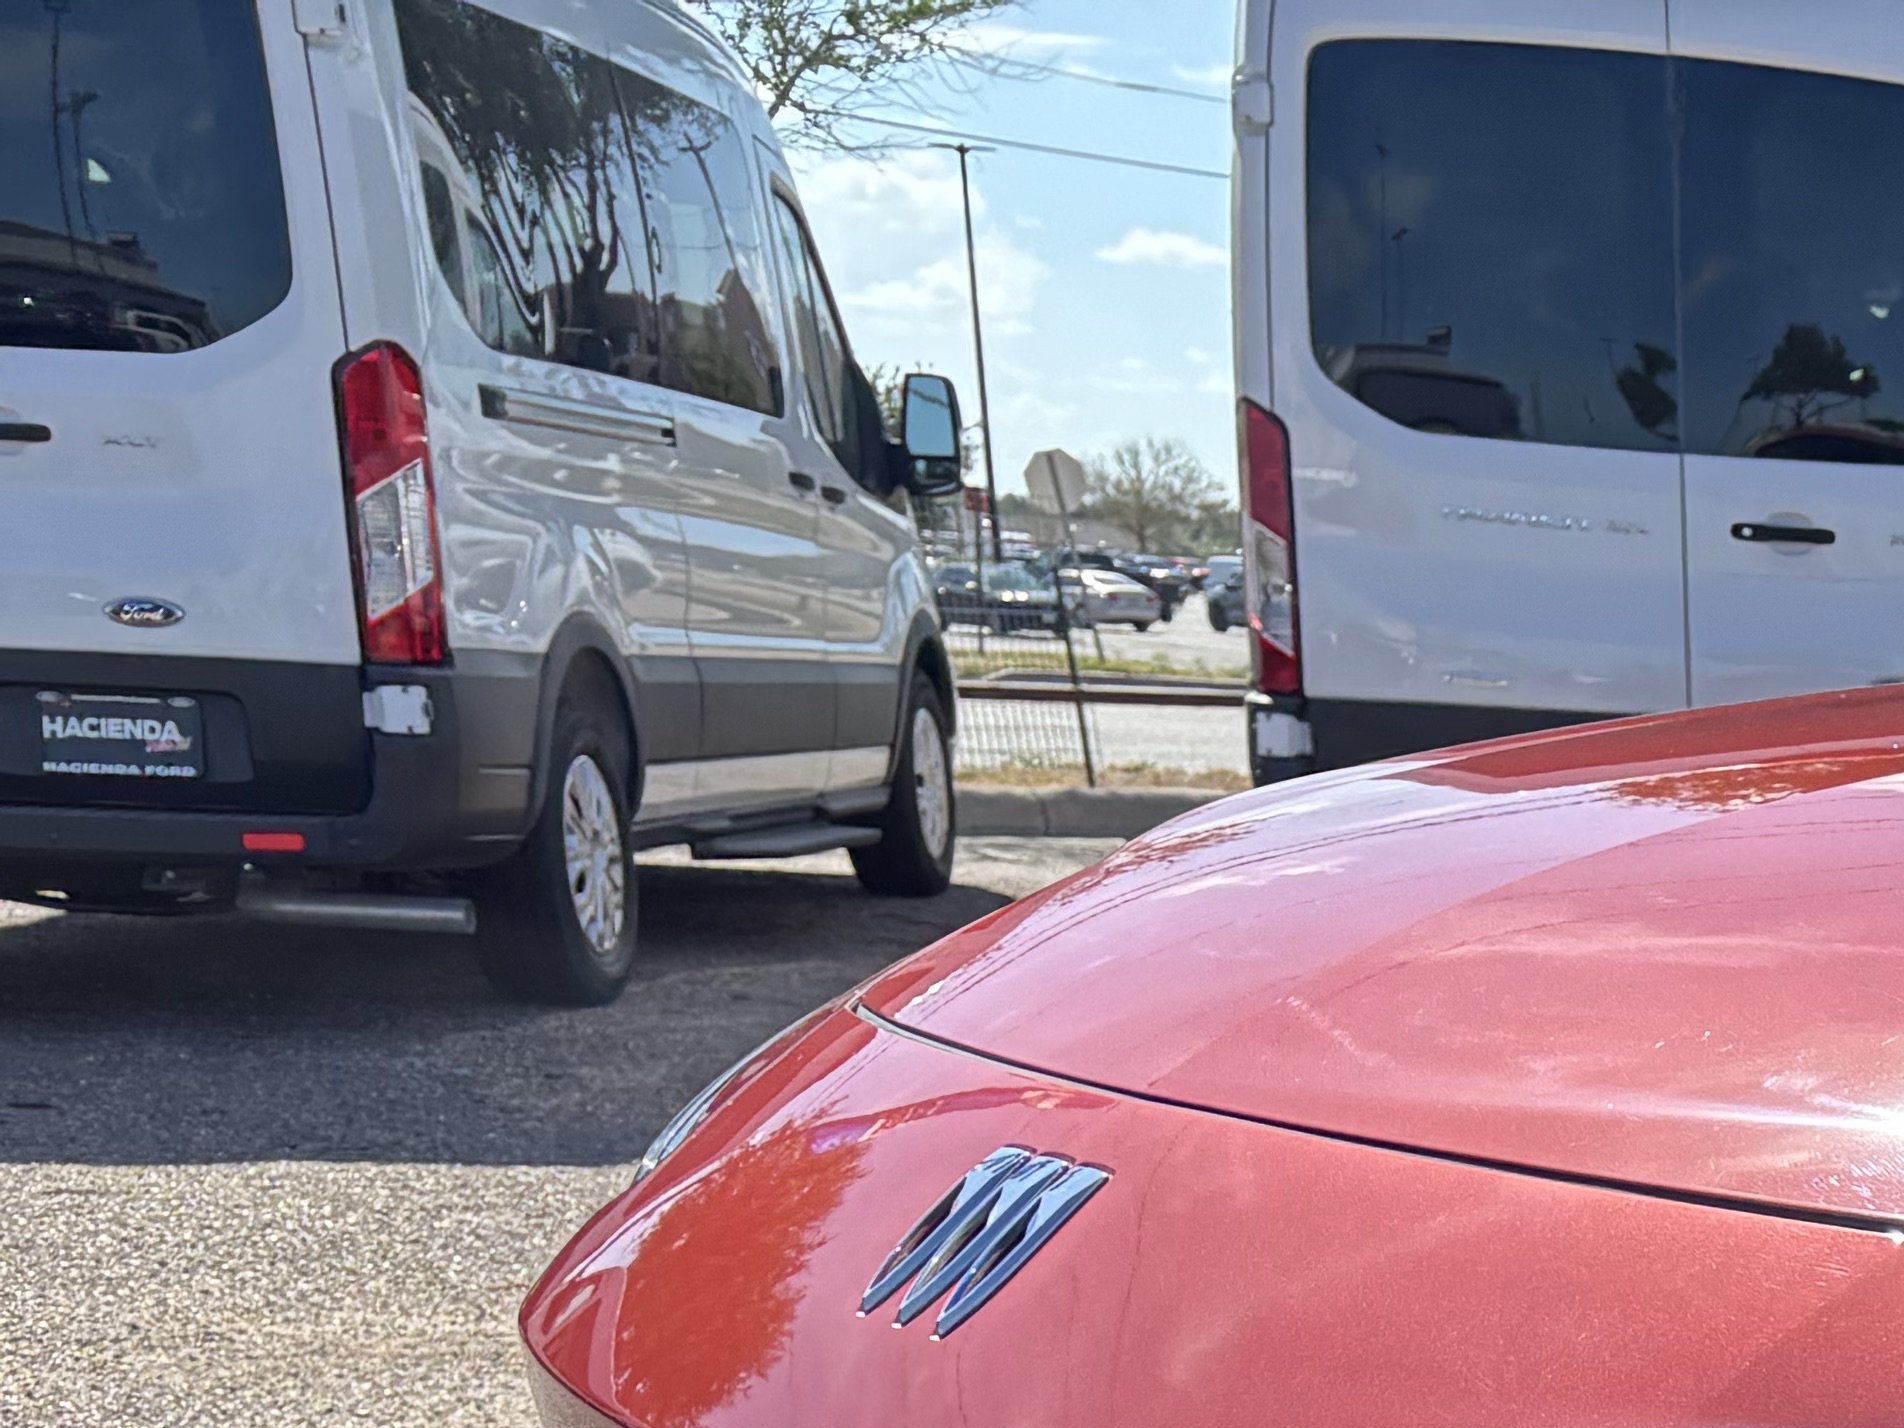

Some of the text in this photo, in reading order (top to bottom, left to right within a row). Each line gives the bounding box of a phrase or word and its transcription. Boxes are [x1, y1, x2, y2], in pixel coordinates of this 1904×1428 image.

[42, 715, 181, 742] HACIENDA
[42, 761, 197, 777] HACIENDA FORD
